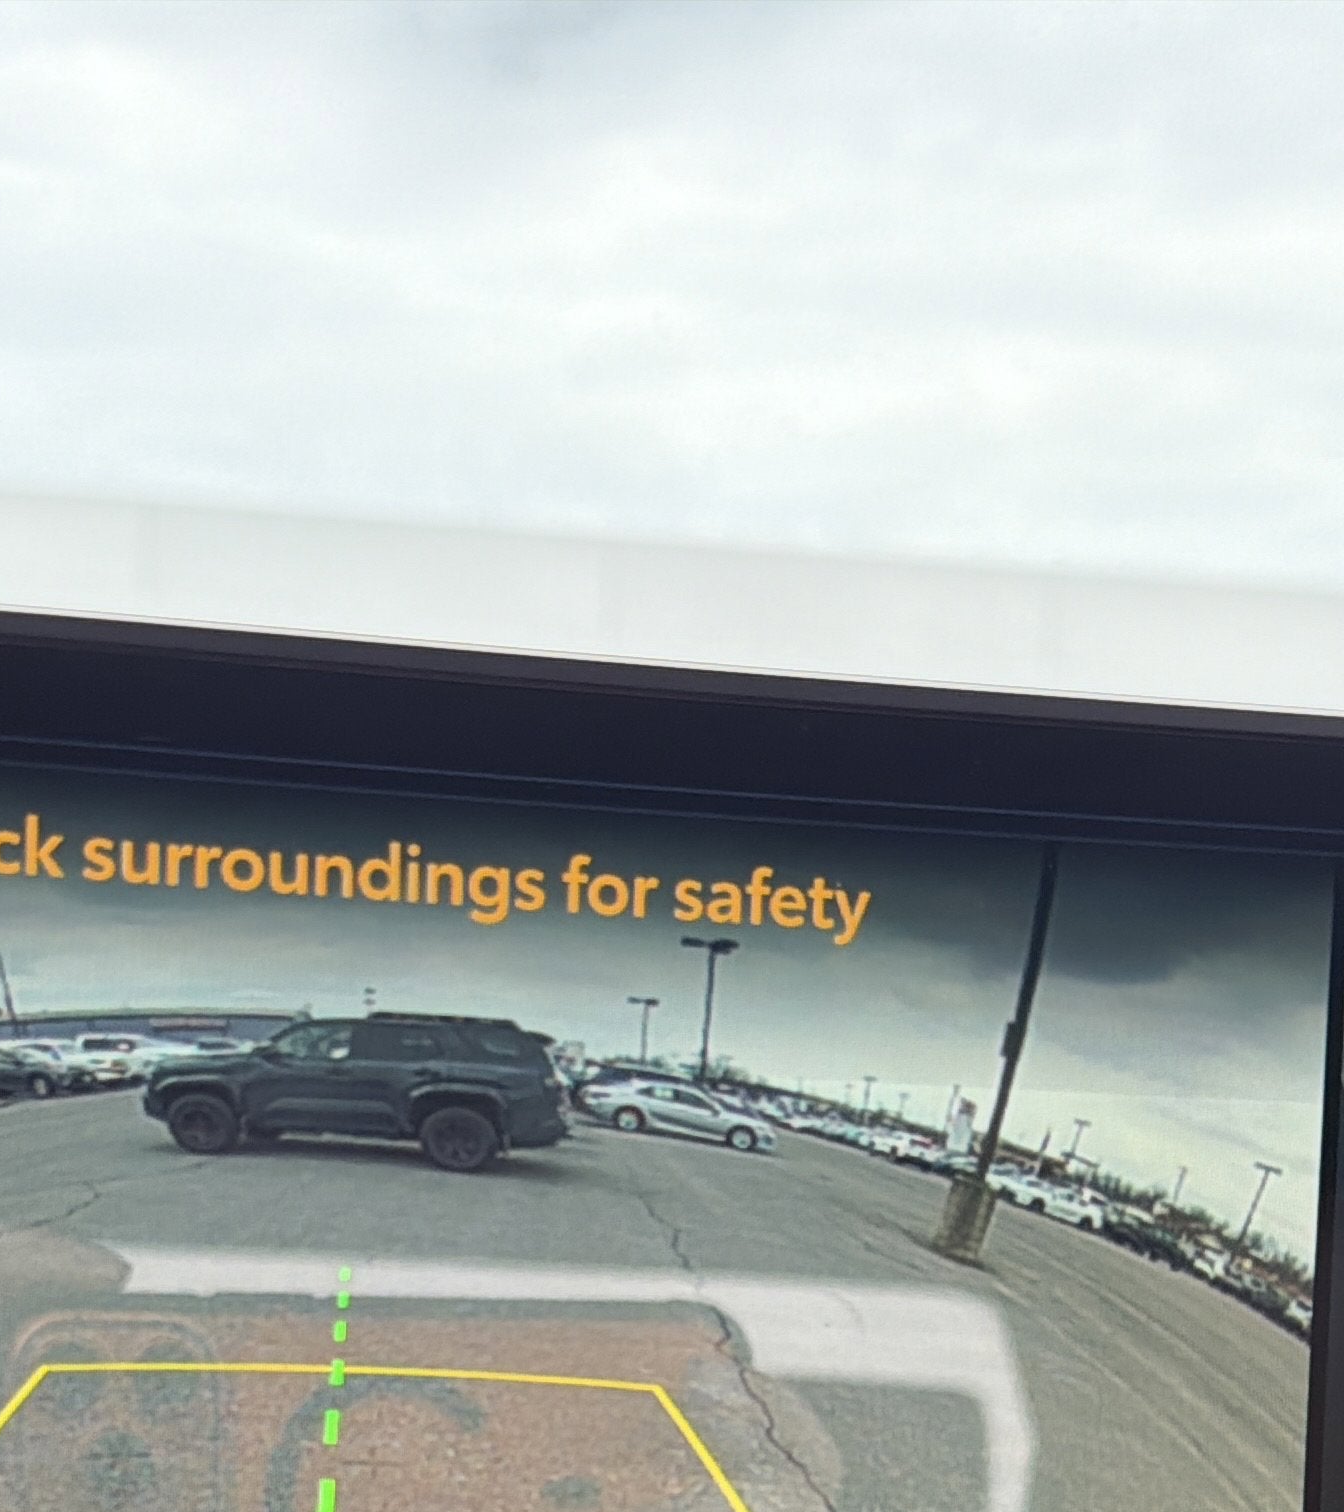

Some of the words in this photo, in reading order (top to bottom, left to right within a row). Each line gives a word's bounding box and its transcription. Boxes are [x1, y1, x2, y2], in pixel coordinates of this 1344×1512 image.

[82, 837, 546, 926] surroundings
[561, 854, 660, 919] for
[673, 866, 872, 946] safety
